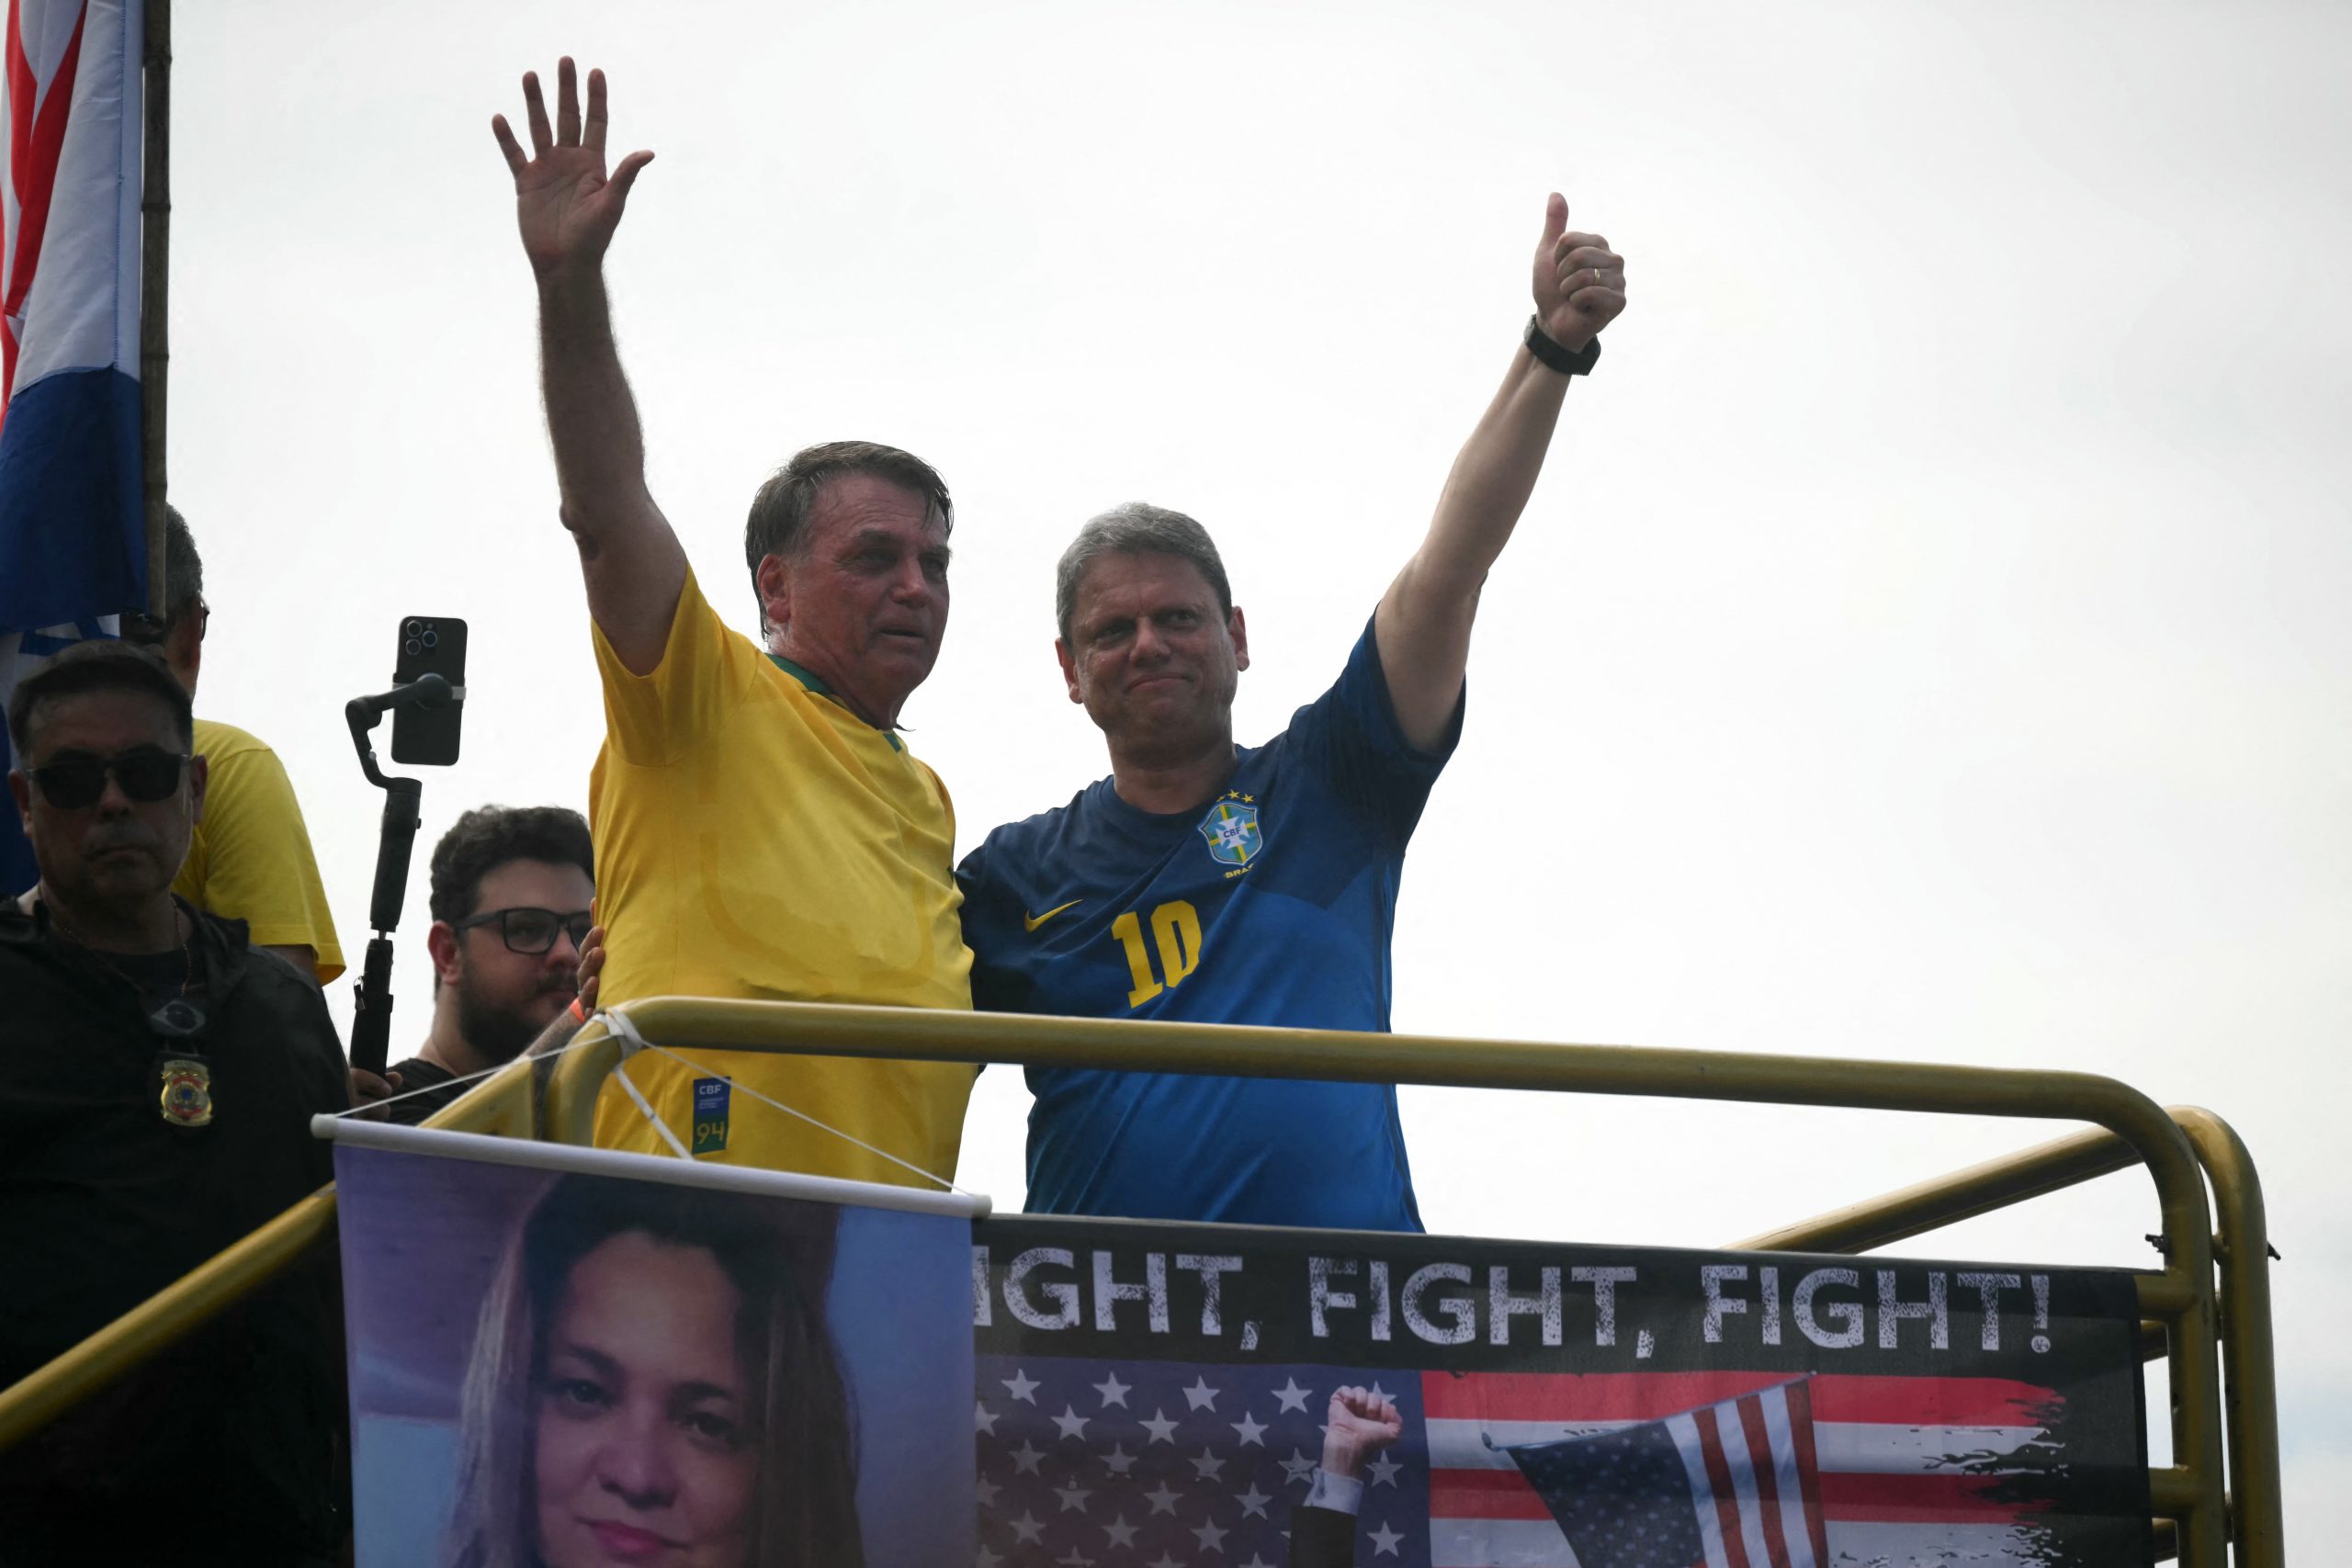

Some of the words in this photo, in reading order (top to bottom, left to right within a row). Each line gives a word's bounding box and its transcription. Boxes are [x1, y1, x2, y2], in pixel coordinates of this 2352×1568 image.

[1223, 827, 1242, 838] CBF
[1111, 899, 1203, 1009] 10
[699, 1085, 723, 1095] CBF
[696, 1122, 725, 1145] 94
[972, 1245, 1263, 1350] IGHT,
[1308, 1256, 1655, 1359] FIGHT,
[1701, 1265, 2052, 1353] FIGHT!
